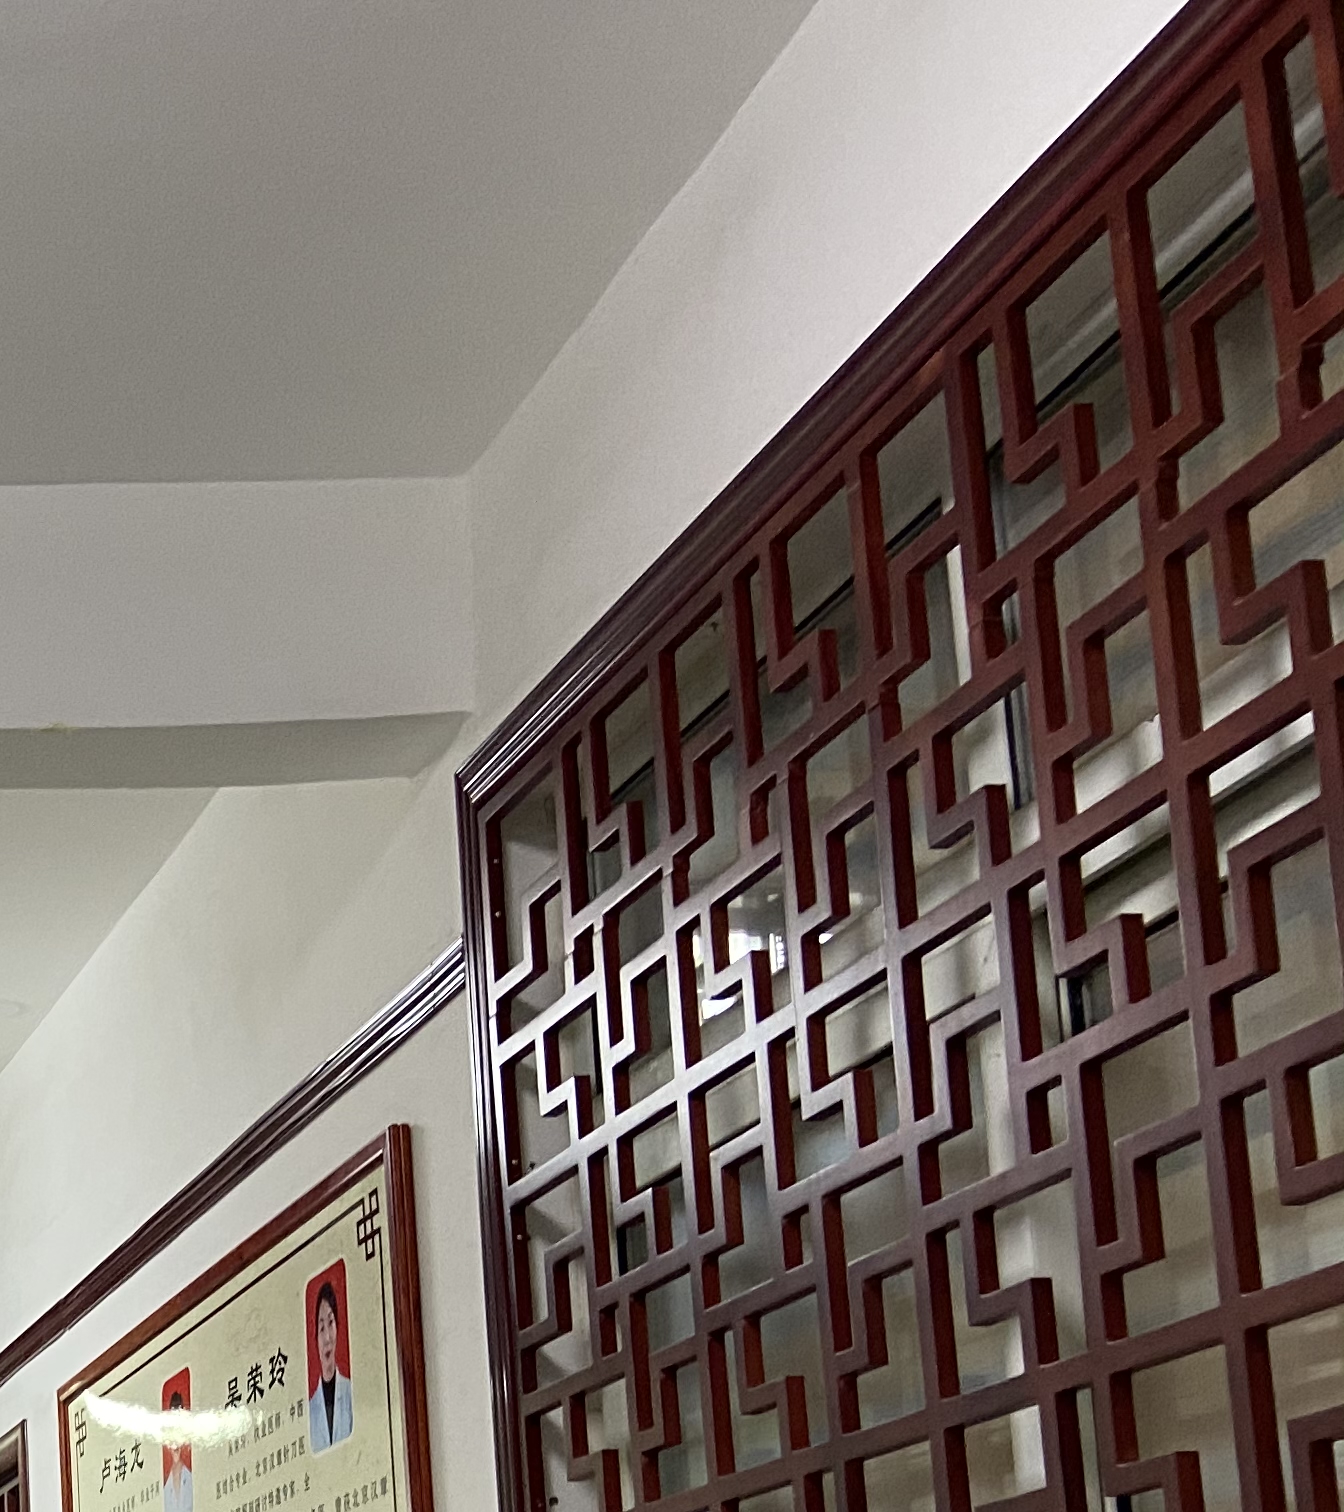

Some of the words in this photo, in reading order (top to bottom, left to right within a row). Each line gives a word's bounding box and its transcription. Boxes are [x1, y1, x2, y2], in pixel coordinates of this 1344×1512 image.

[222, 1345, 289, 1411] 吴荣玲
[98, 1434, 146, 1495] 卢海龙
